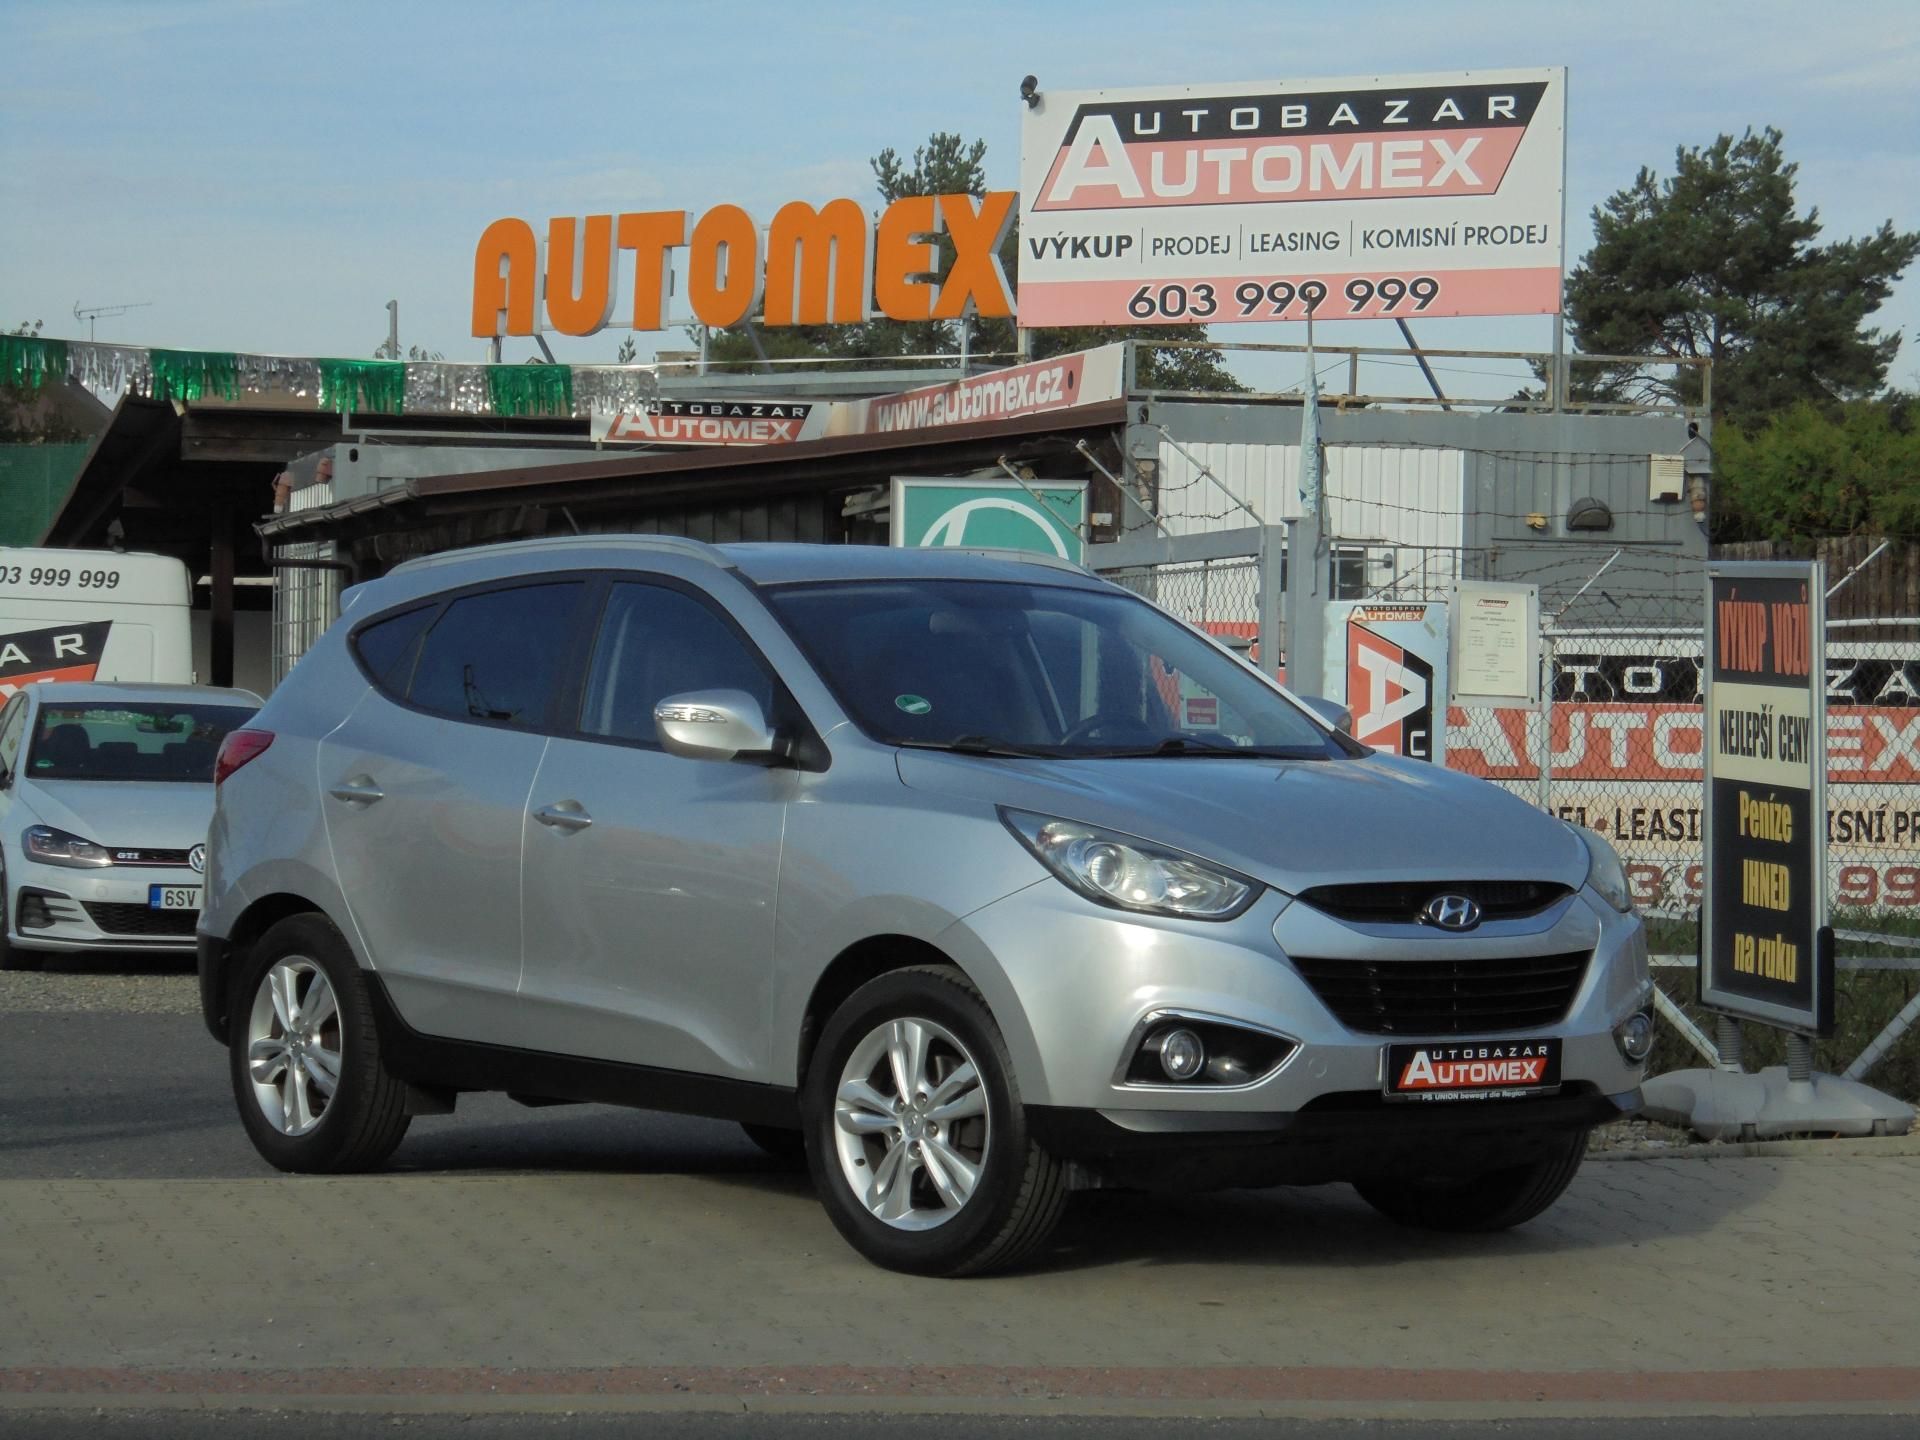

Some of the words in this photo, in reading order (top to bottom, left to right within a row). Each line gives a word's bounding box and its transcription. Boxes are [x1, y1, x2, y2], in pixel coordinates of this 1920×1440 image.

[1047, 113, 1484, 202] AUTOMEX
[1029, 231, 1133, 260] VÝKUP
[1151, 235, 1231, 257] PRODEJ
[1250, 230, 1340, 254] LEASING
[1362, 221, 1459, 250] KOMISNÍ
[1464, 224, 1548, 247] PRODEJ
[471, 191, 1019, 338] AUTOMEX
[1127, 283, 1218, 320] 603
[1234, 280, 1328, 317] 999
[1345, 276, 1440, 314] 999
[877, 366, 1063, 433] www.automex.cz
[614, 410, 792, 441] AUTOMEX
[29, 567, 71, 587] 999
[78, 569, 120, 589] 999
[1349, 605, 1421, 621] AUTOMEX
[1718, 588, 1767, 673] VÝKUP
[1771, 584, 1810, 677] VOZŮ
[1718, 703, 1773, 760] NEJLEPŠÍ
[1778, 713, 1810, 764] CENY
[1615, 807, 1704, 842] LEASI
[1738, 791, 1793, 843] Peníze
[164, 890, 196, 907] 6SV
[1742, 858, 1790, 912] IHNED
[1733, 932, 1754, 975] na
[1757, 934, 1798, 984] ruku
[1404, 1051, 1539, 1086] AUTOMEX
[1434, 1092, 1459, 1101] UNION
